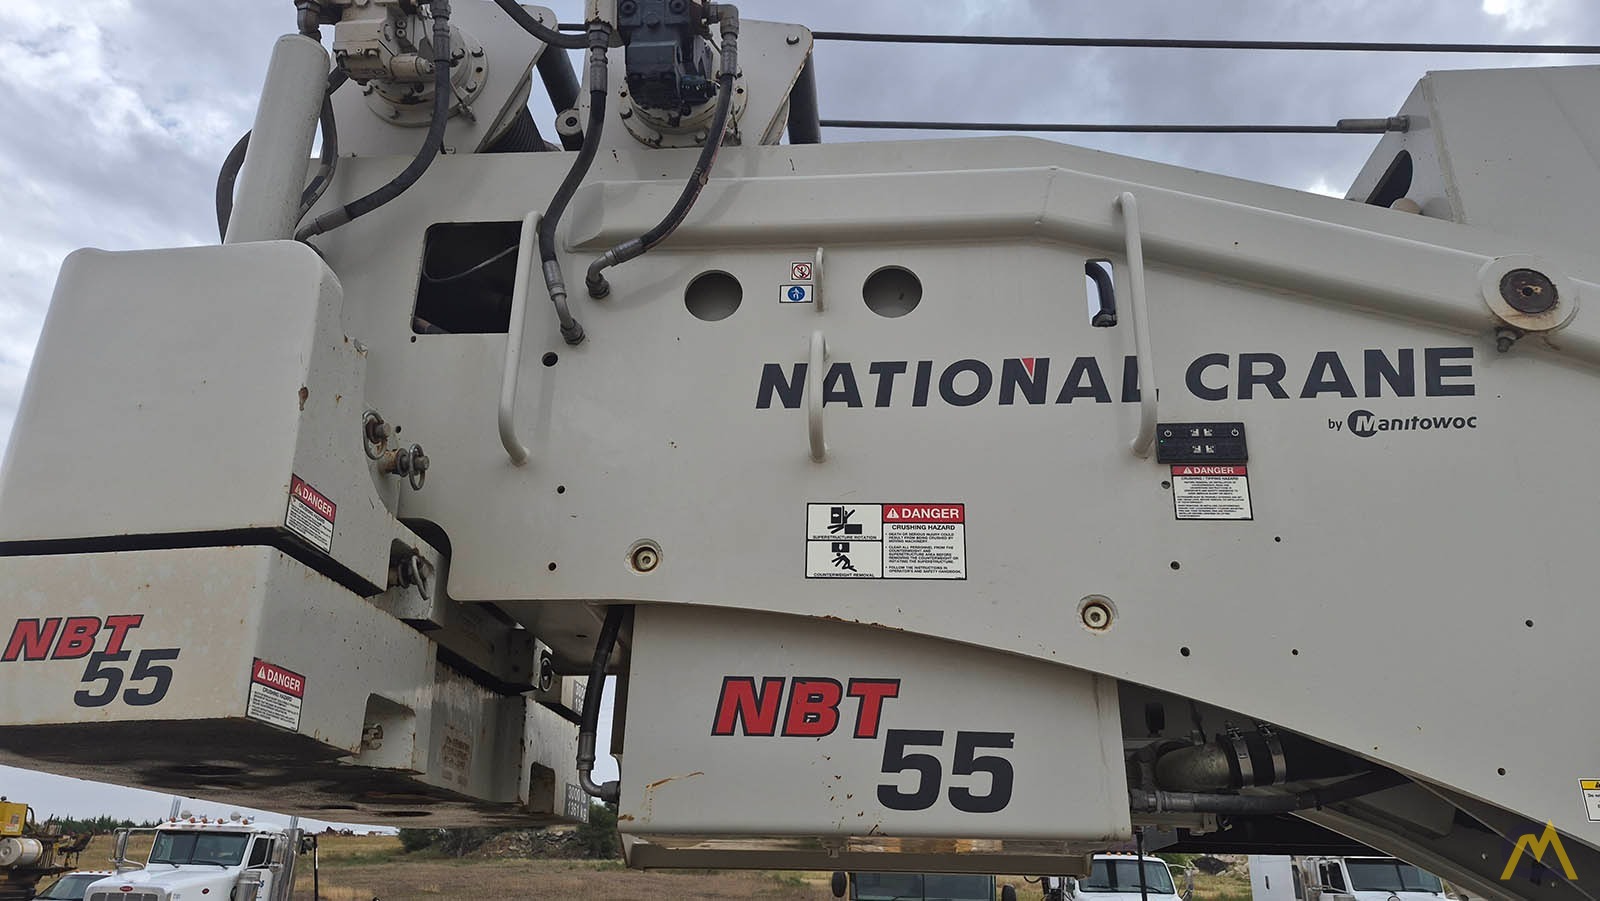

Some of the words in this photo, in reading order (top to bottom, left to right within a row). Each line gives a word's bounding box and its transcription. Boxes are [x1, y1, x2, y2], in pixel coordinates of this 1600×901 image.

[755, 355, 1159, 409] NATIONAL
[1185, 347, 1475, 401] CRANE
[1328, 419, 1342, 431] by
[1347, 410, 1477, 438] Manitowoc
[1193, 466, 1234, 474] DANGER
[302, 487, 332, 517] DANGER
[901, 508, 959, 519] DANGER
[0, 614, 144, 662] NBT
[73, 648, 181, 708] 55
[267, 668, 301, 692] DANGER
[710, 676, 901, 739] NBT
[877, 729, 1015, 814] 55
